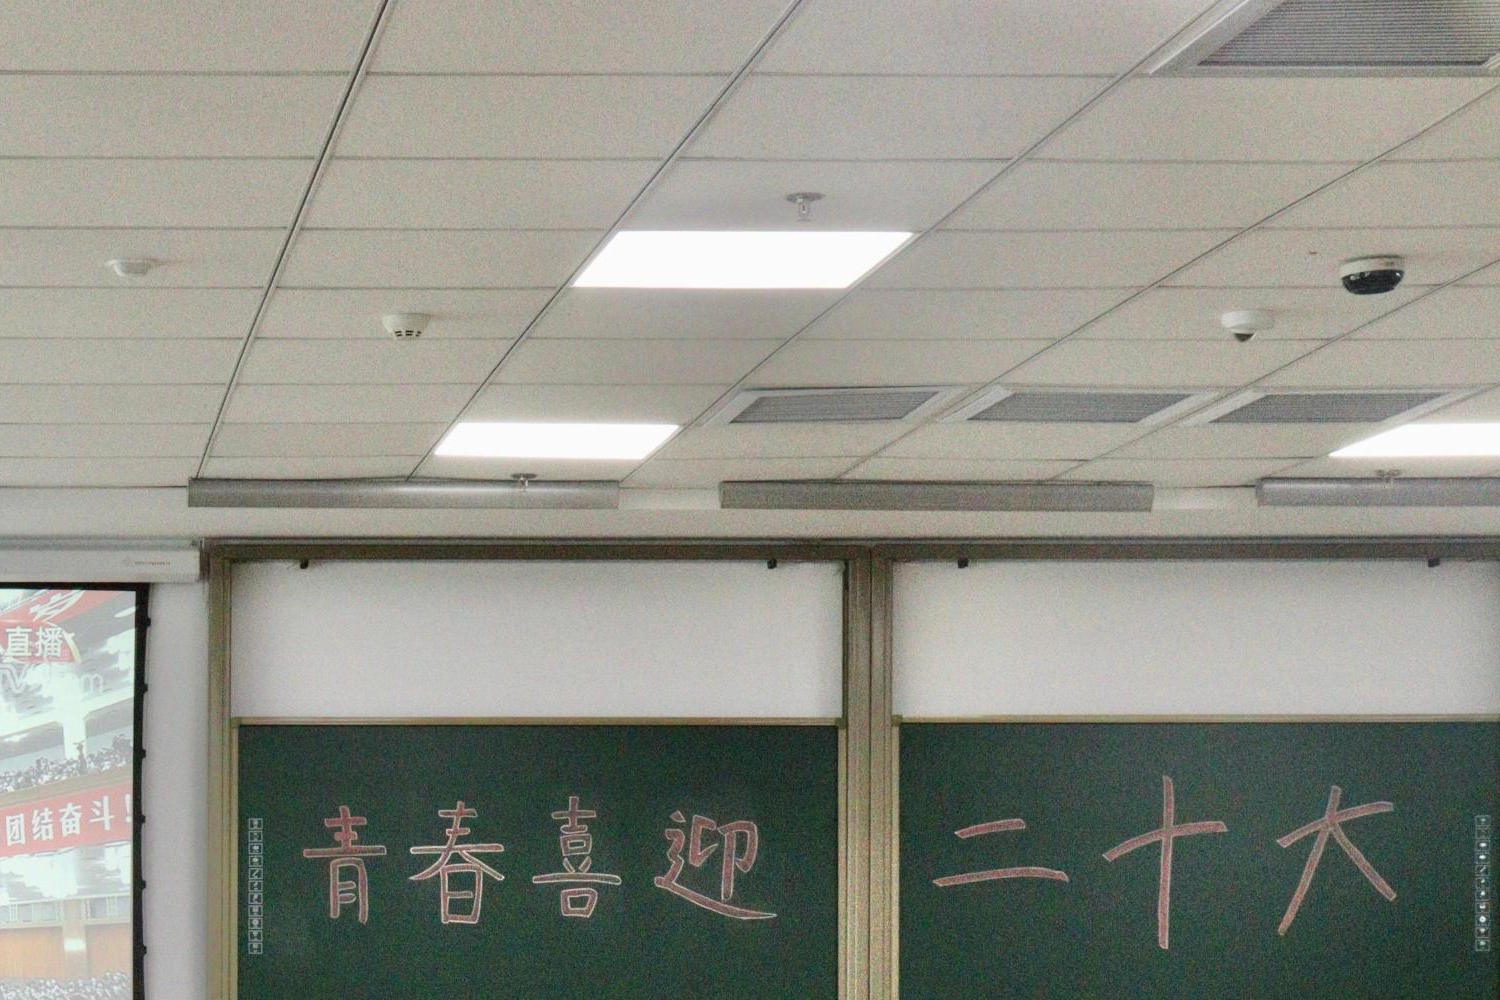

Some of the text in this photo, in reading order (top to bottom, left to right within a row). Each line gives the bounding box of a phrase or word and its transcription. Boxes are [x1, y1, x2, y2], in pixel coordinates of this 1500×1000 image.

[4, 625, 64, 658] 直播
[302, 796, 778, 924] 青春喜迎
[932, 775, 1397, 950] 二十大
